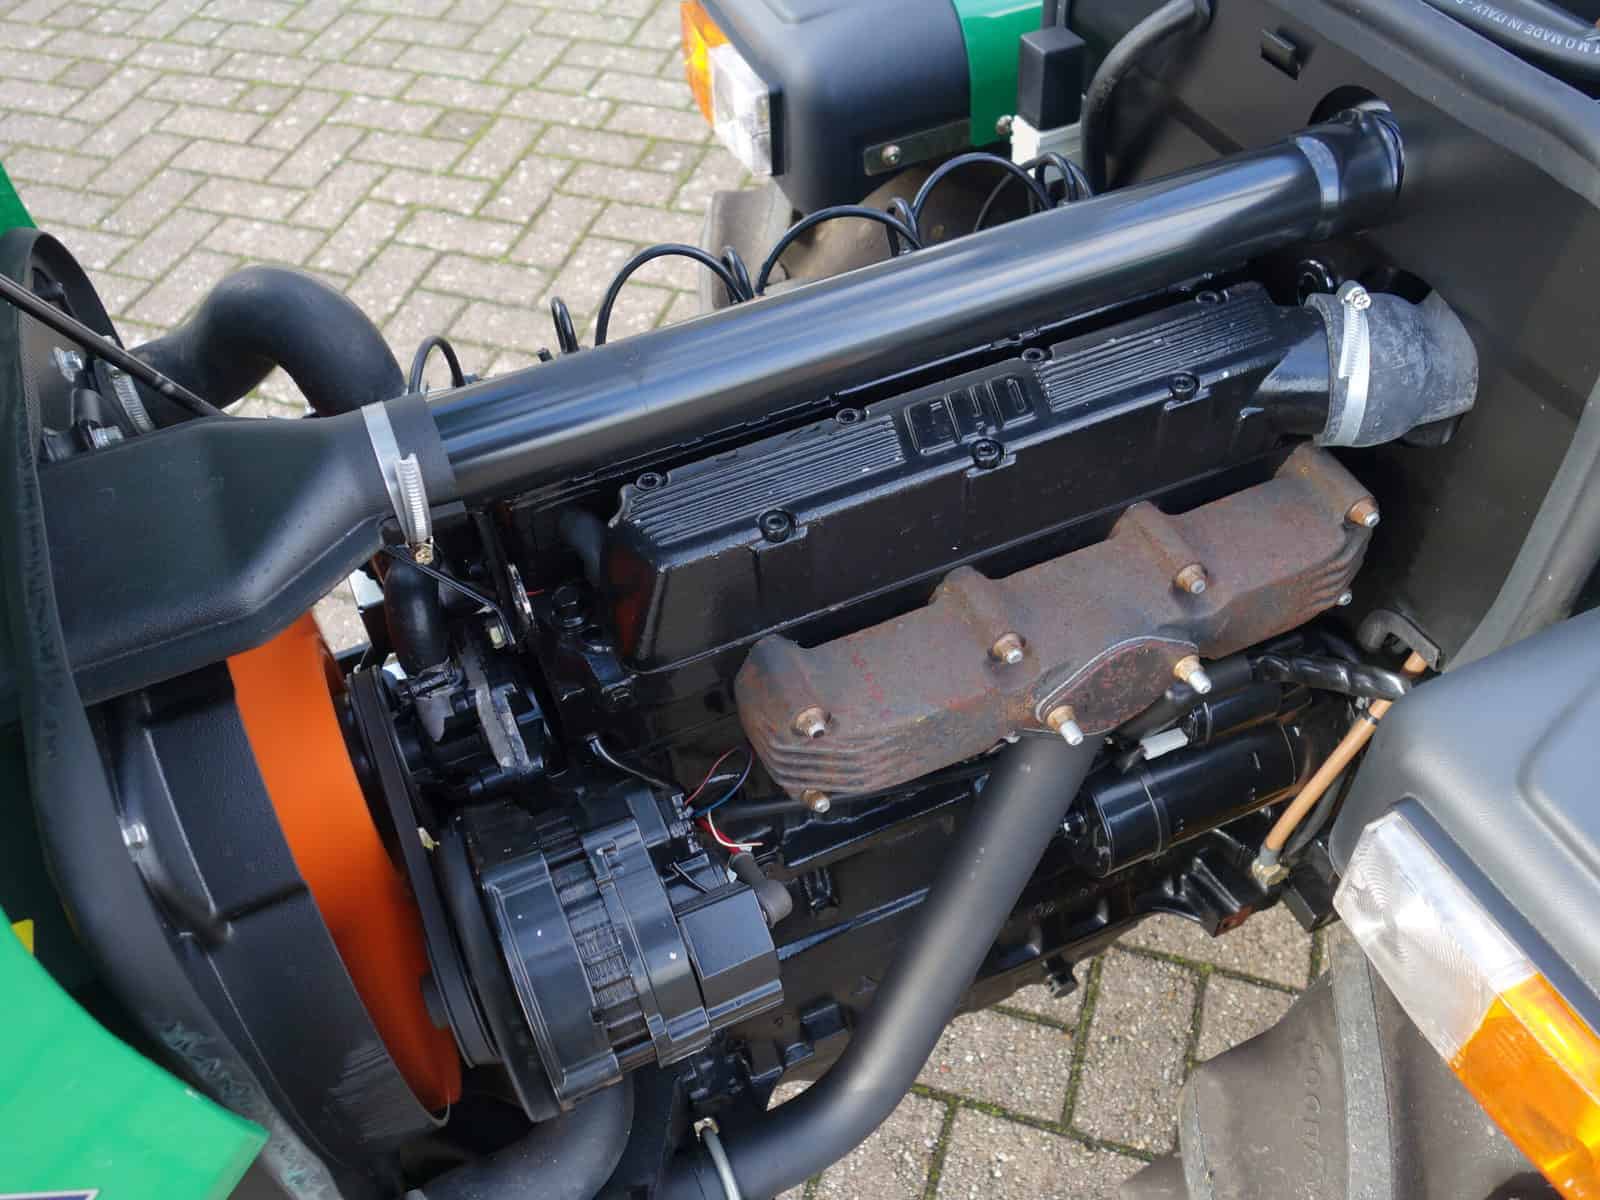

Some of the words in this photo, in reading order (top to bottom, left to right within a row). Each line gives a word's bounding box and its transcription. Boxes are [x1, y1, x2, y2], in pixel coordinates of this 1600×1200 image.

[1472, 4, 1508, 25] ITALY
[1507, 17, 1523, 31] IN
[1523, 23, 1563, 45] MADE
